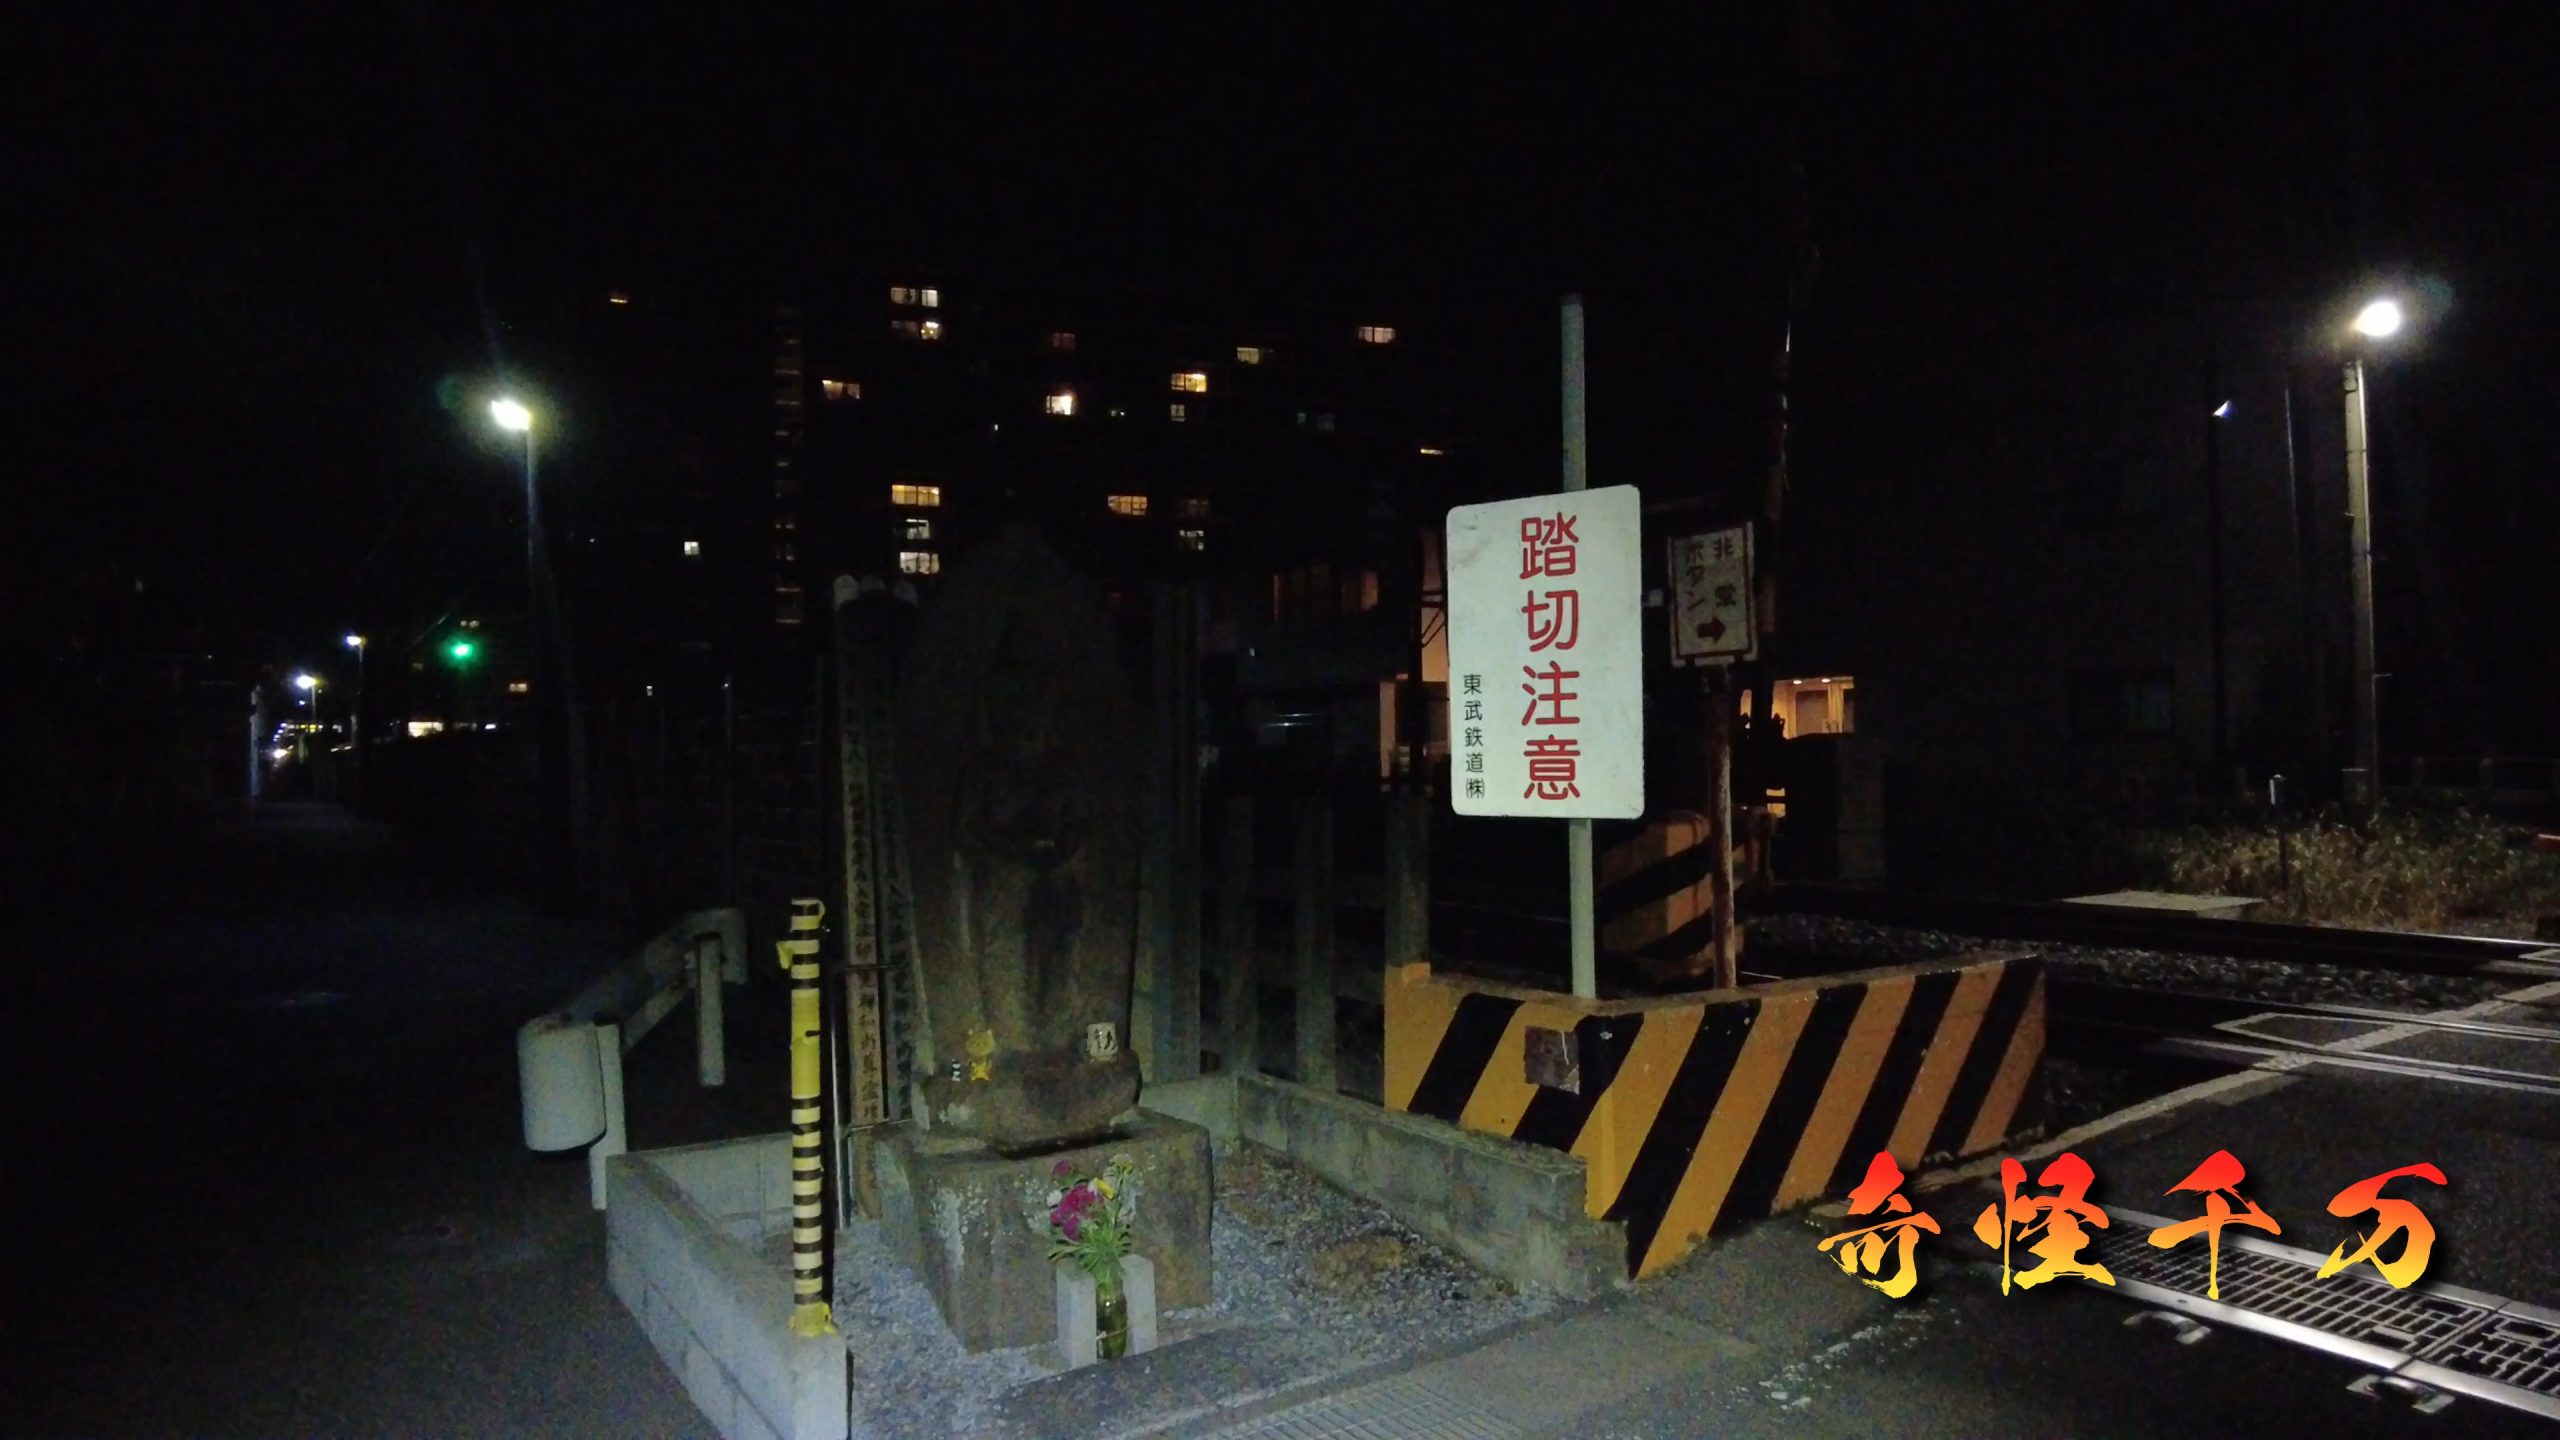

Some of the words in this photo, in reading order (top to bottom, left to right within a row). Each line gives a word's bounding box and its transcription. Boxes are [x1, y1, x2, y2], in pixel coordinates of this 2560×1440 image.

[1519, 511, 1581, 800] 踏切注意
[1685, 540, 1706, 611] ボタン
